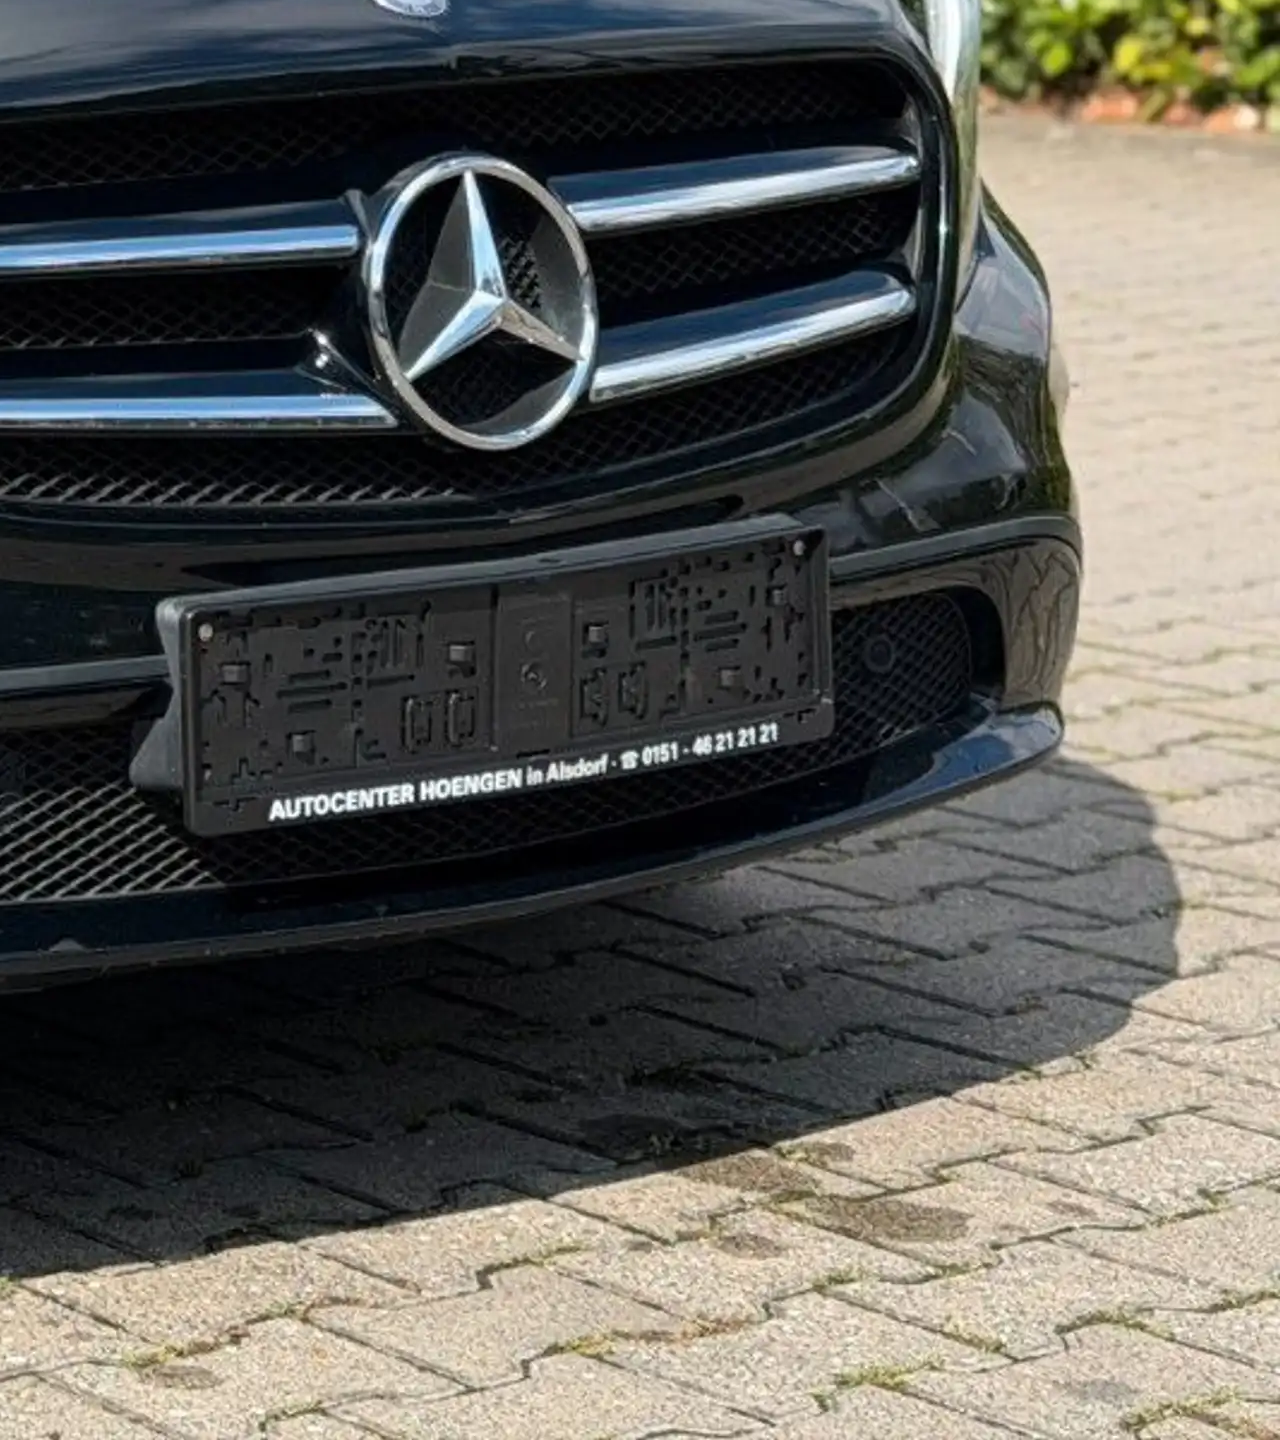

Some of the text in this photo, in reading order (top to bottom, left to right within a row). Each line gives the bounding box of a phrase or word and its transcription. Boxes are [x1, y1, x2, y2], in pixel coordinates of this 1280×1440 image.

[267, 782, 415, 821] AUTOCENTER
[419, 768, 523, 801] HOENGEN
[526, 767, 544, 786] in
[545, 753, 609, 783] Alsdorf
[641, 741, 679, 766] 0151
[692, 734, 713, 756] 46
[714, 730, 734, 752] 21
[737, 726, 756, 748] 21
[759, 722, 779, 744] 21
